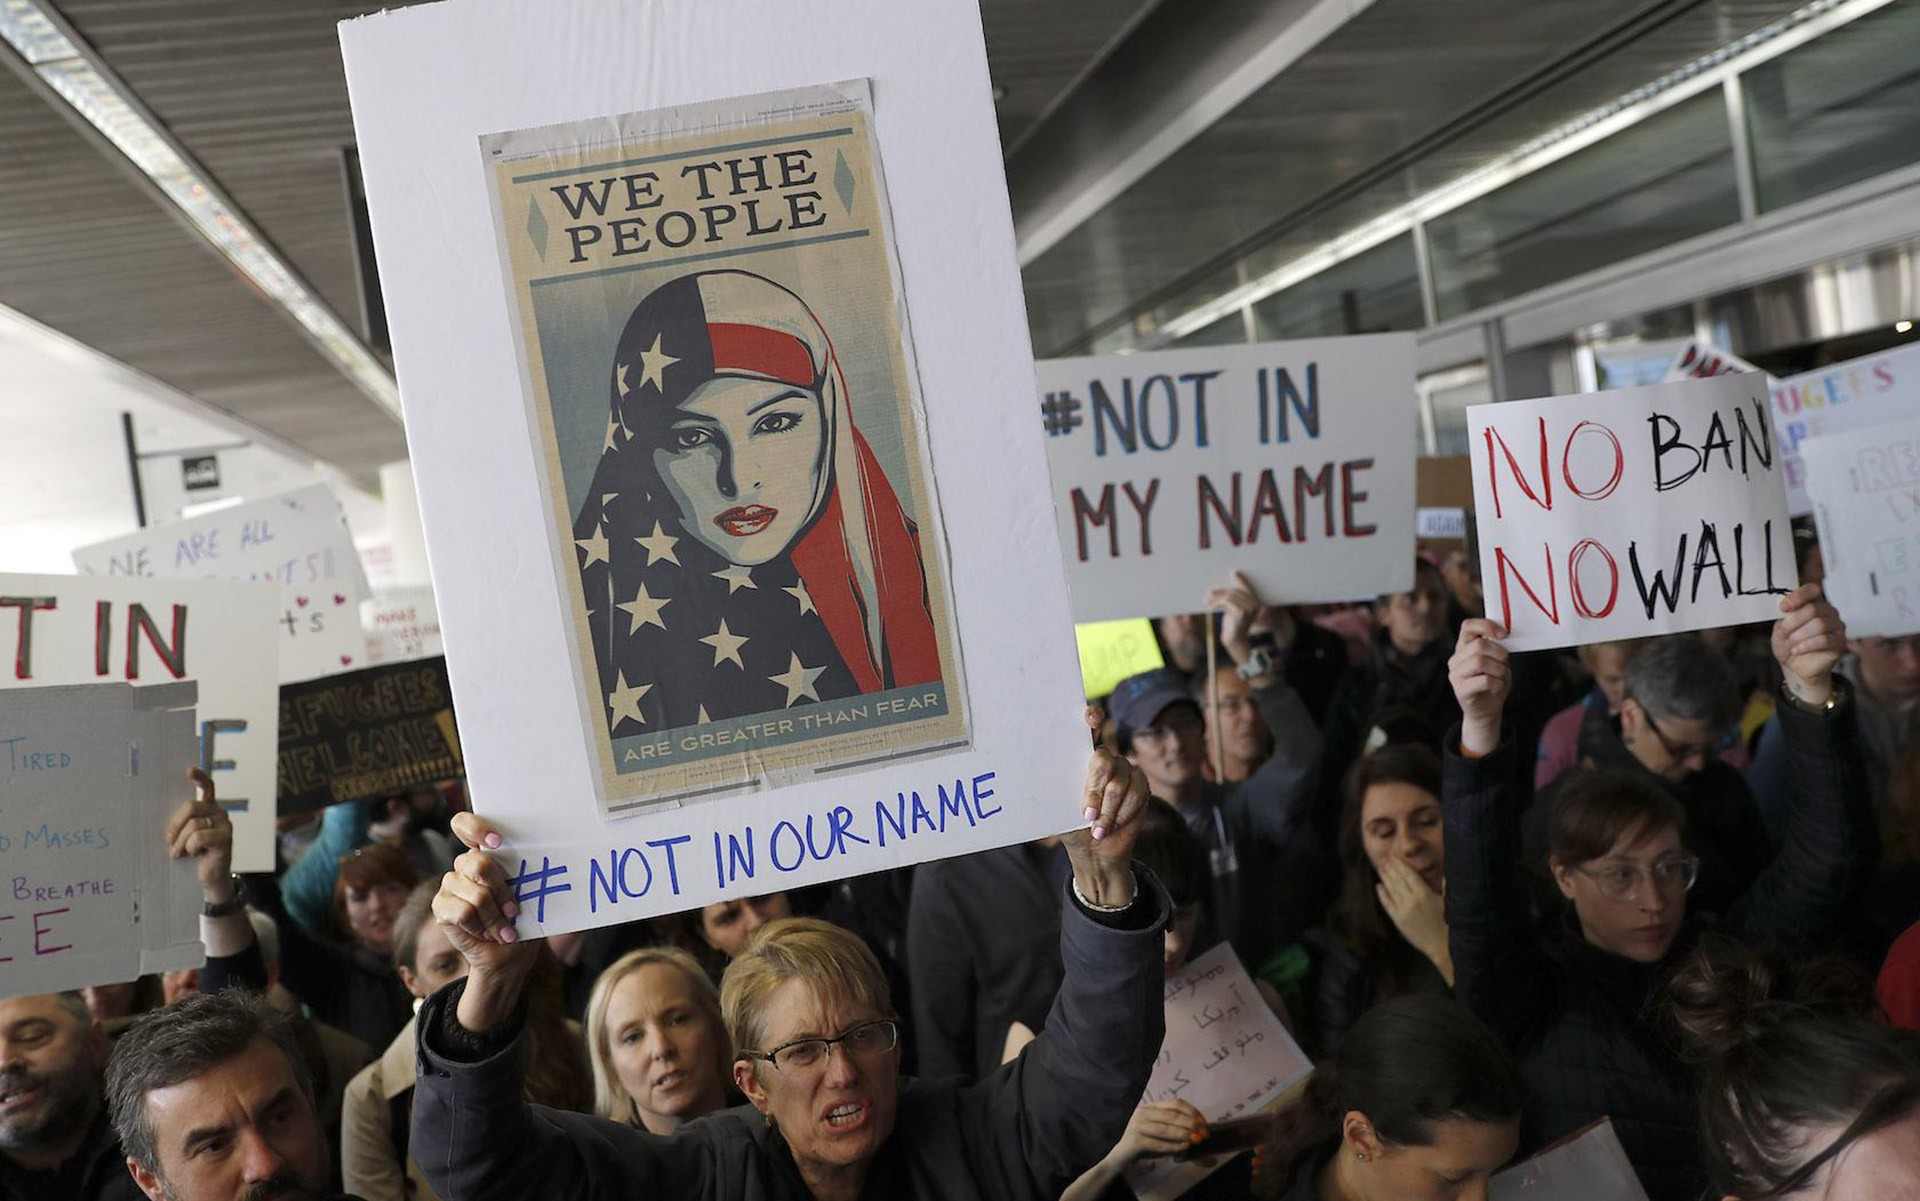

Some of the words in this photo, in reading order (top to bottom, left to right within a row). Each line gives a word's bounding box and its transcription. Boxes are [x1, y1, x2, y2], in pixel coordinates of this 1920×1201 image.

[551, 172, 664, 219] WE
[681, 149, 818, 200] THE
[565, 191, 827, 263] PEOPLE
[1257, 362, 1320, 445] IN
[1485, 417, 1624, 518] NO
[1648, 397, 1772, 492] BAN
[175, 529, 219, 567] ARE
[242, 519, 275, 549] ALL
[1070, 478, 1160, 562] MY
[1197, 459, 1377, 550] NAME
[1495, 538, 1618, 633] NO
[1628, 520, 1793, 620] WALL
[95, 600, 187, 680] IN
[0, 737, 71, 771] TIRED
[624, 741, 672, 763] ARE
[681, 720, 793, 751] GREATER
[799, 705, 868, 730] THAN
[877, 692, 938, 716] FEAR
[24, 824, 110, 850] MASSES
[714, 827, 754, 888] IN
[770, 806, 869, 872] OUR
[876, 772, 1002, 847] NAME
[13, 876, 114, 901] BREATHE
